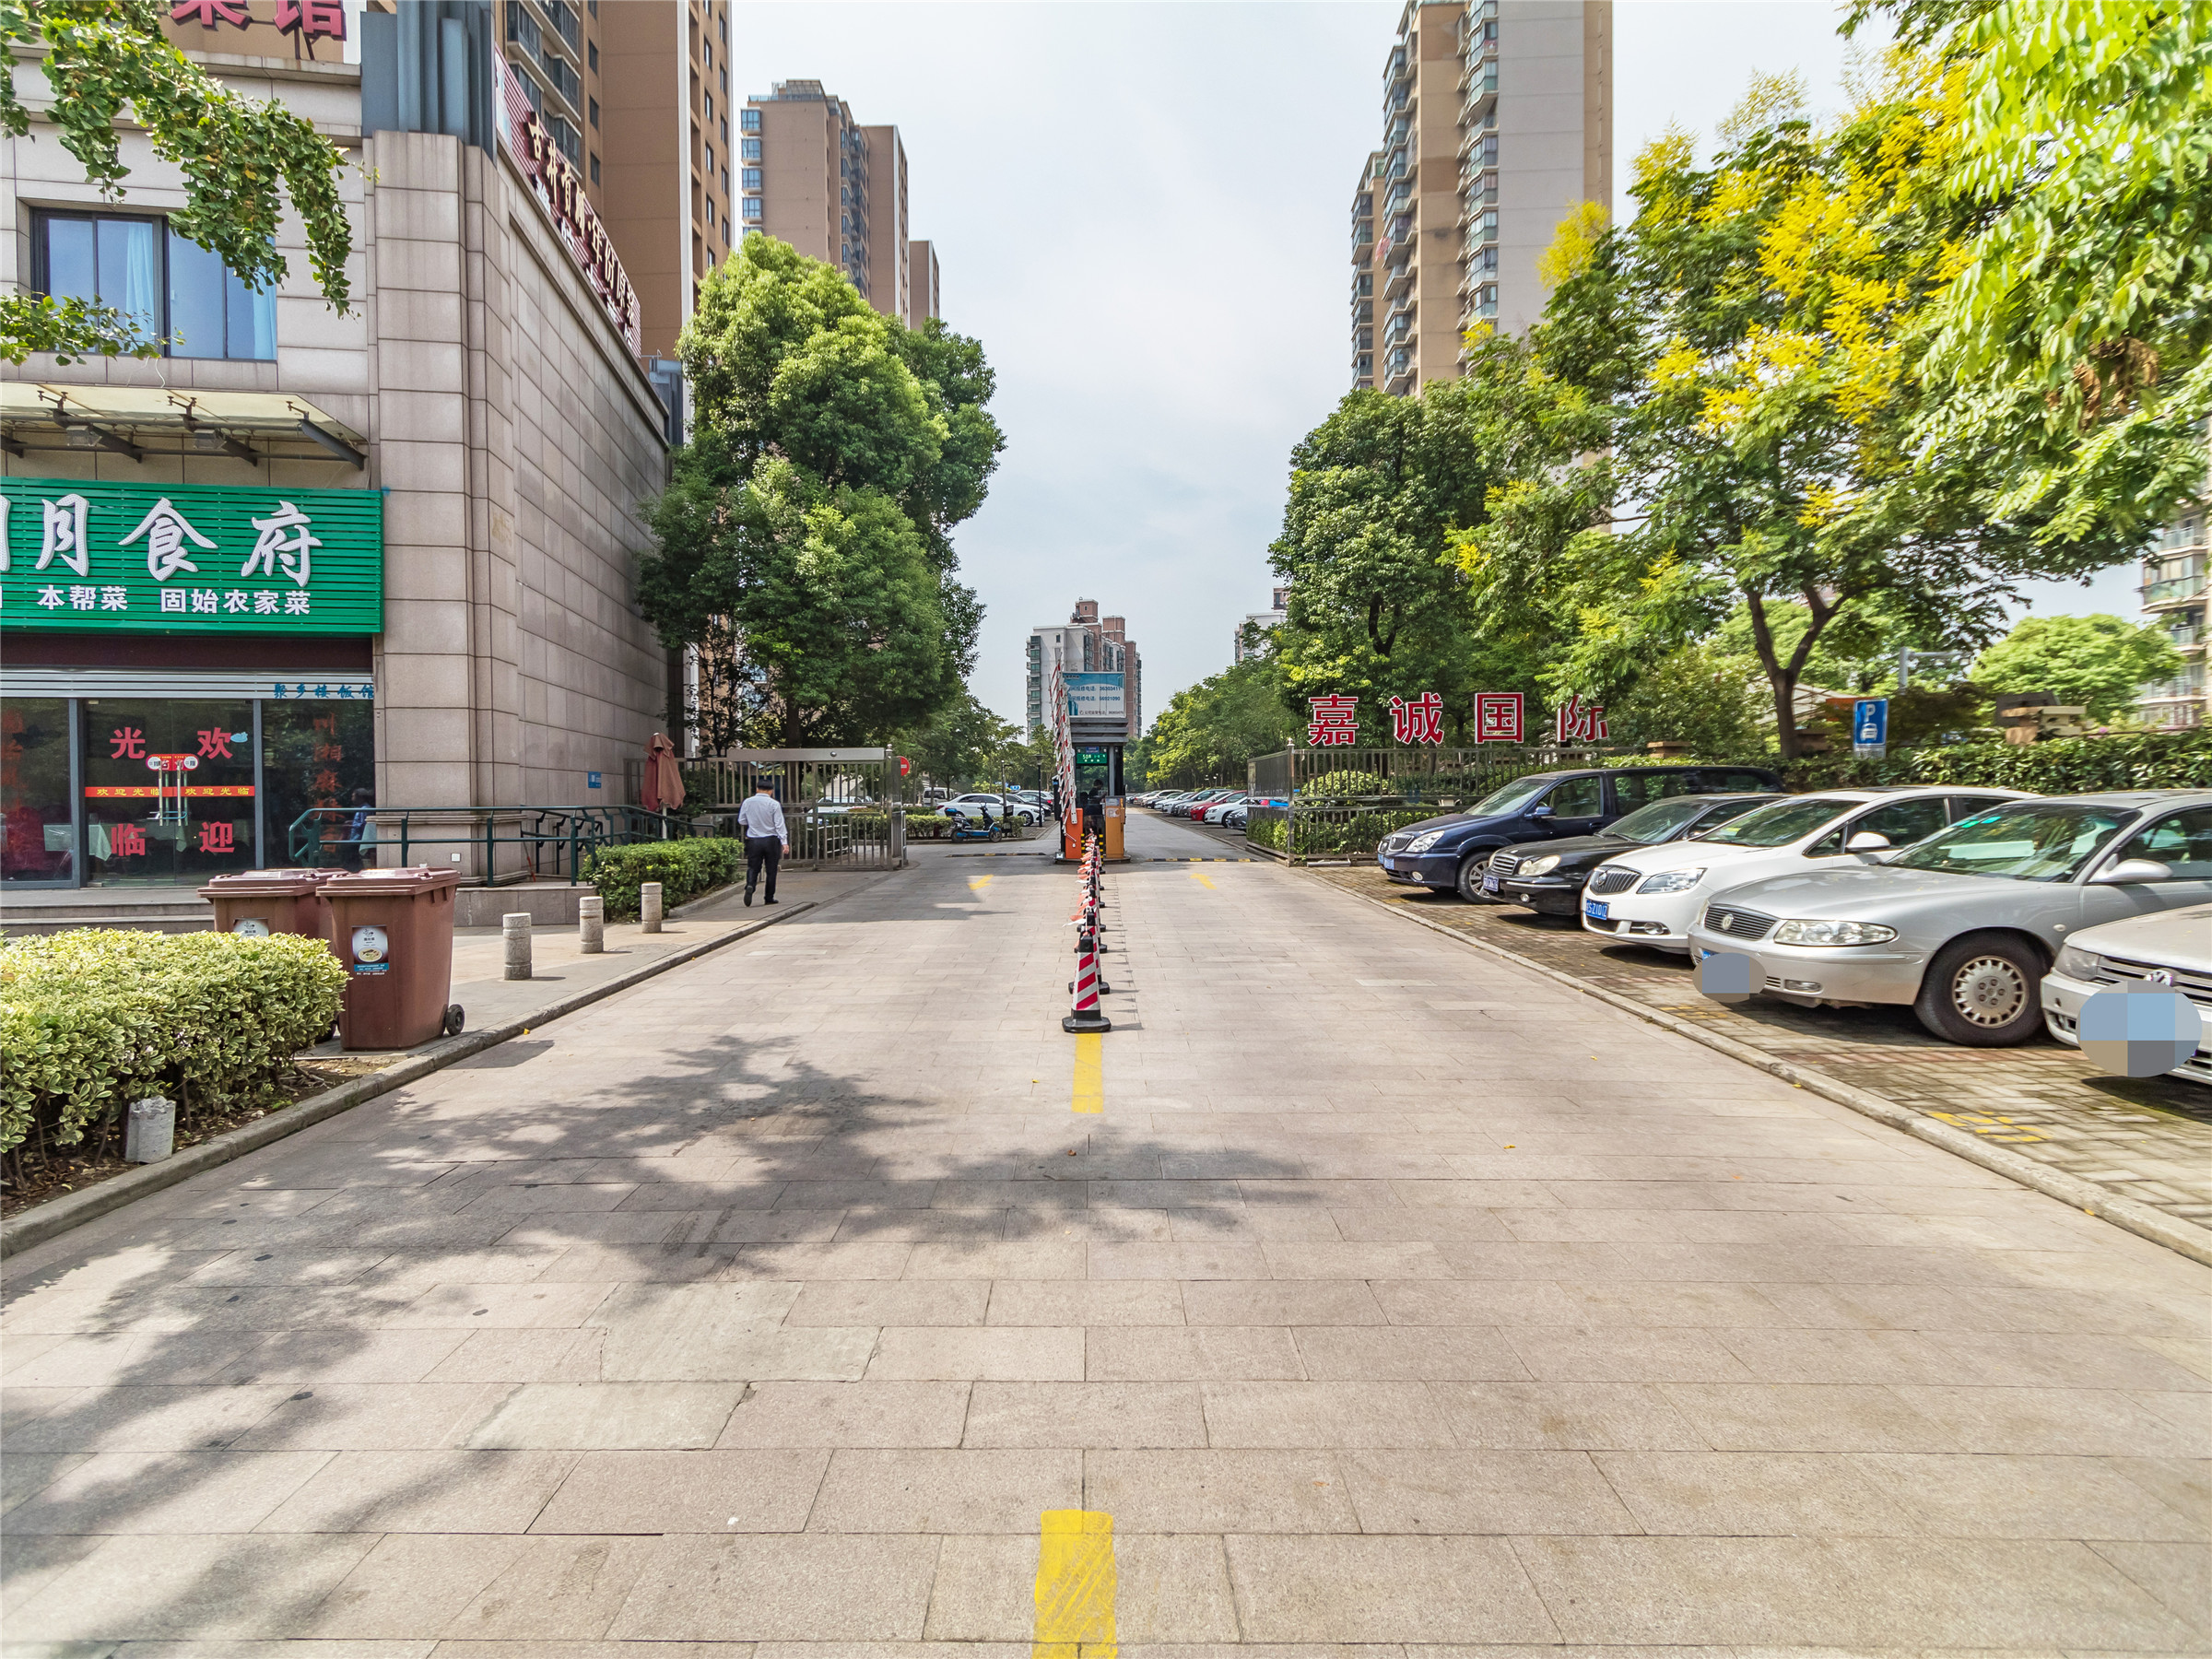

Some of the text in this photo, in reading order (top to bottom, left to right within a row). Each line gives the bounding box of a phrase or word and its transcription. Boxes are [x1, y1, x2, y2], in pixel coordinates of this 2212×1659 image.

[0, 493, 323, 587] 月食府
[37, 584, 311, 615] 本帮菜 固始农家菜
[1308, 691, 1608, 746] 嘉诚国际
[1865, 703, 1876, 723] P
[97, 788, 160, 796] 欢迎光临
[184, 787, 250, 795] 欢迎光临
